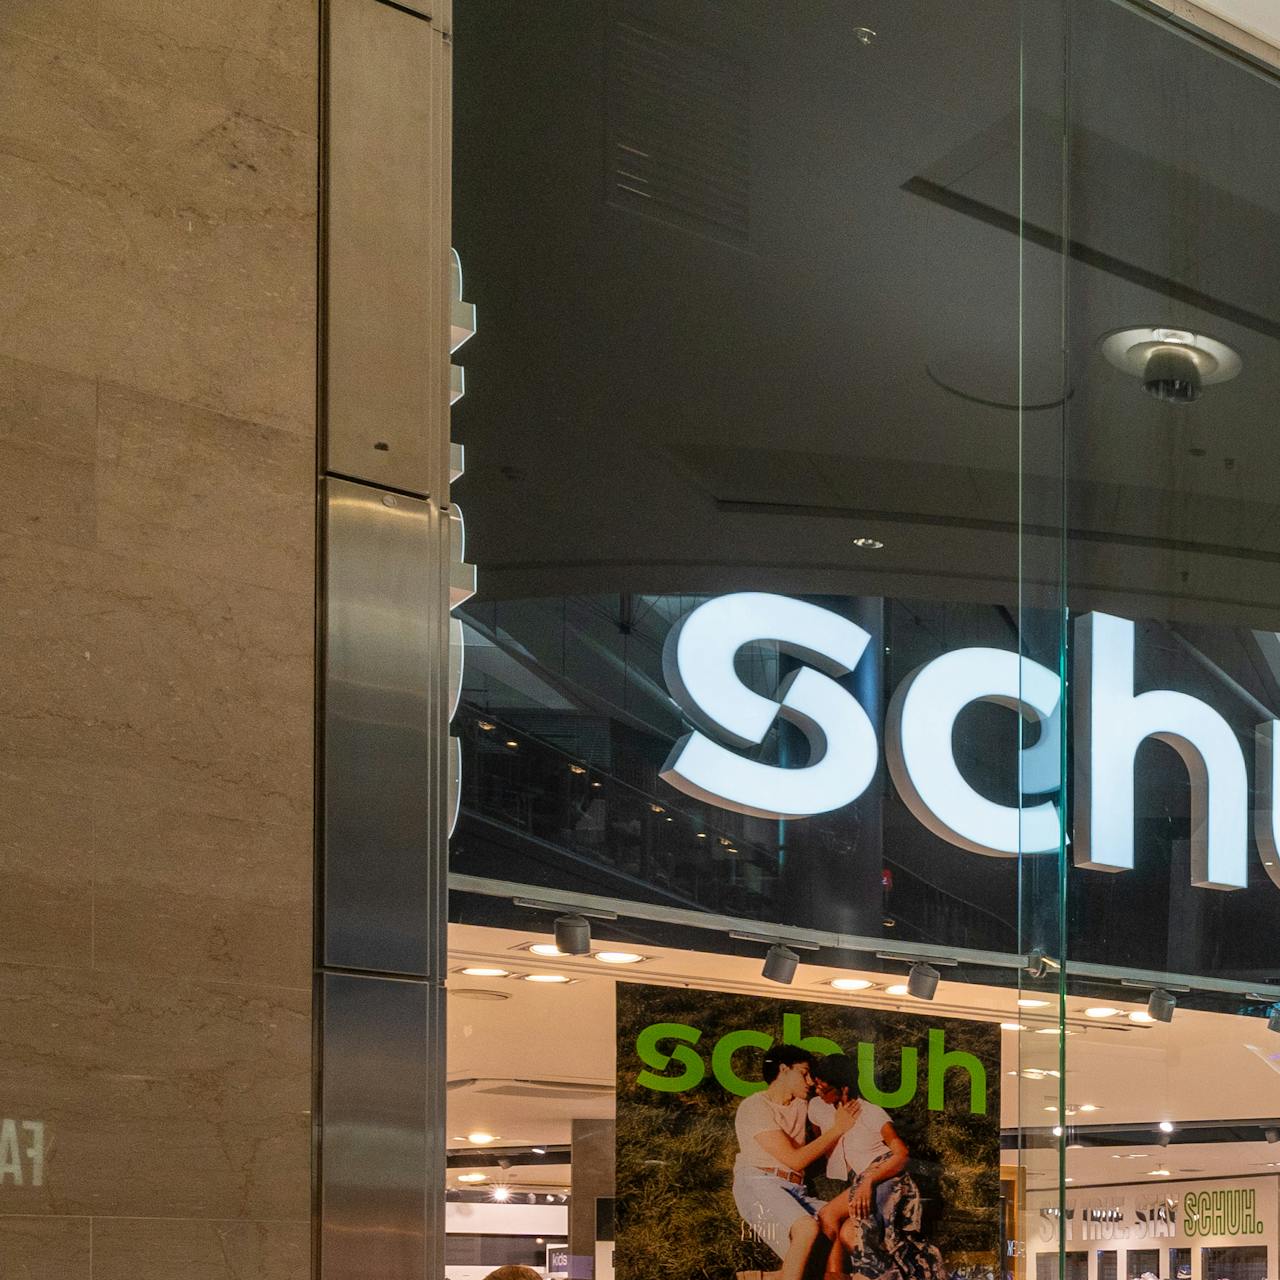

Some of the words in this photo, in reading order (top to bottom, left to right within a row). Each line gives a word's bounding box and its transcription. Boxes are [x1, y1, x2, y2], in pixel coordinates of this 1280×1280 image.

[1039, 1199, 1078, 1243] STY
[1184, 1189, 1264, 1237] SCHUH.
[552, 1253, 568, 1267] kids
